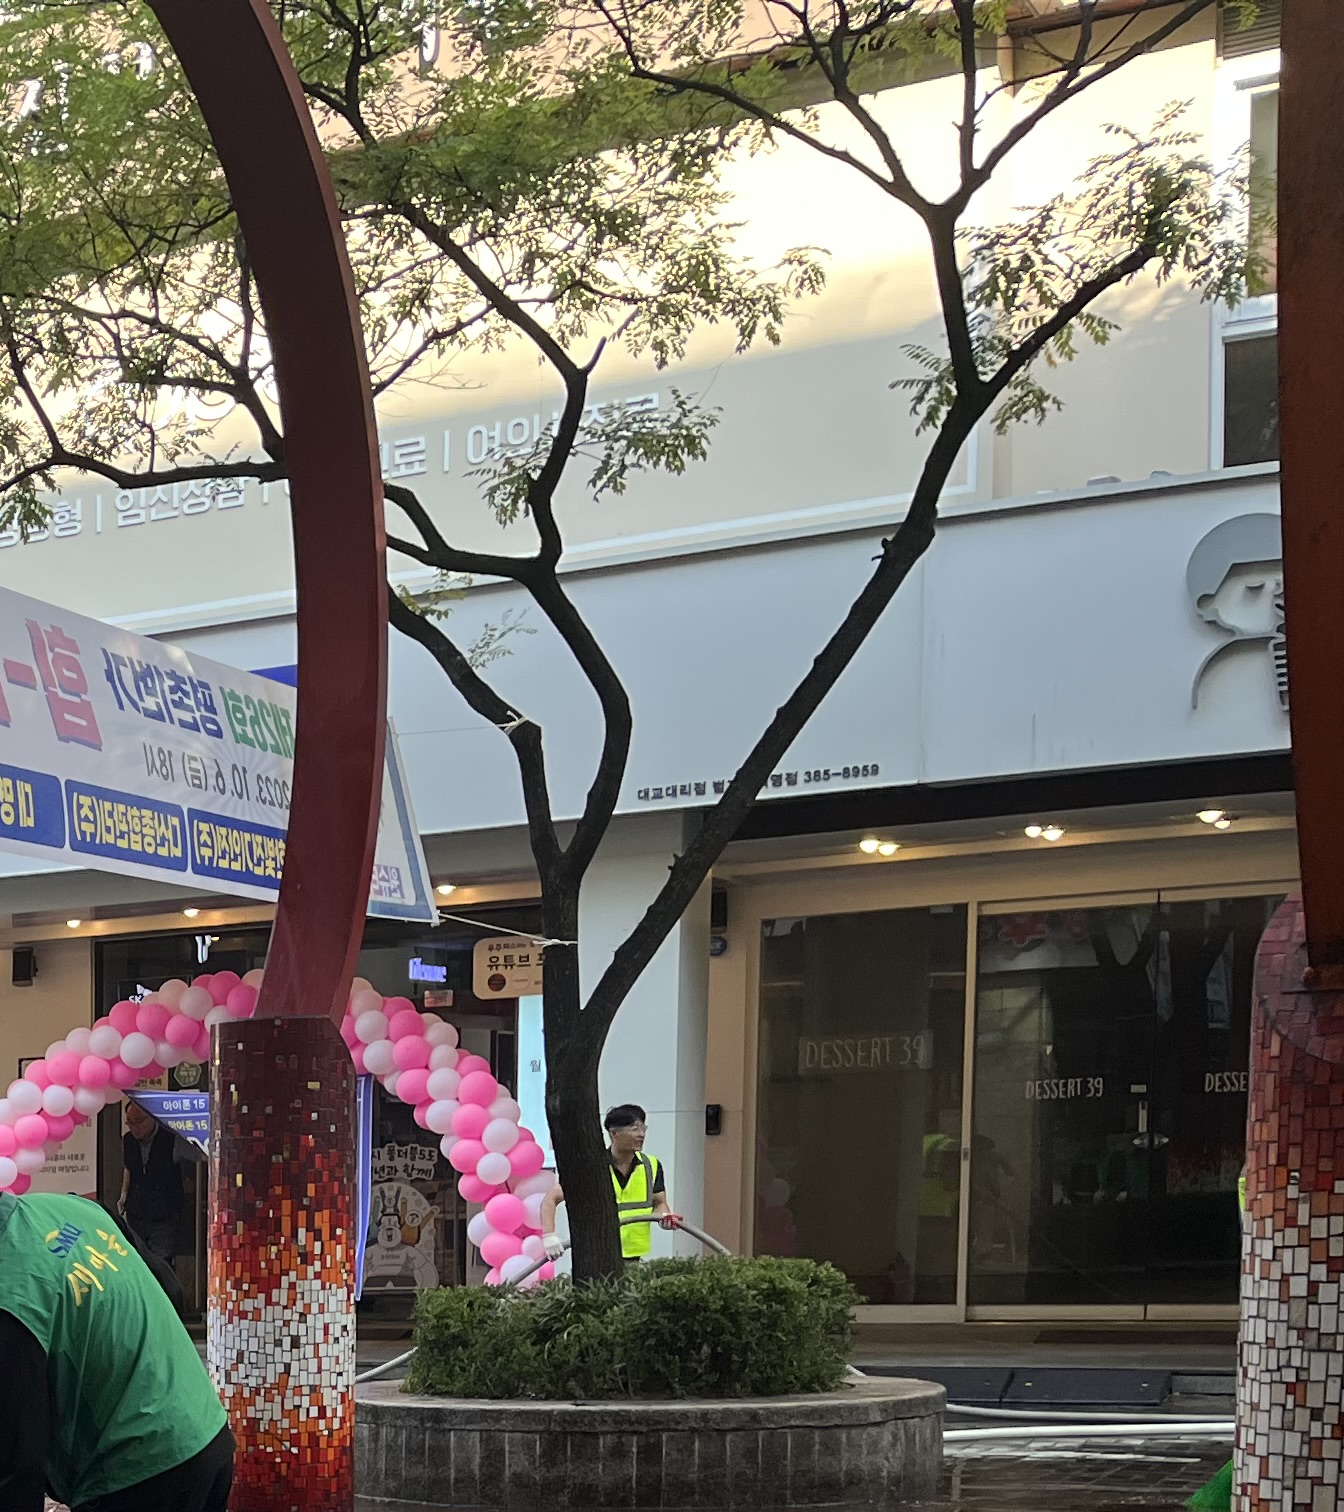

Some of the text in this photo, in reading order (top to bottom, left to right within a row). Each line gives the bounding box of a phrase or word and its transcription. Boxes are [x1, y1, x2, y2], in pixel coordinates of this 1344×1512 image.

[114, 473, 251, 528] 임신상담
[637, 780, 706, 802] 대교대리점
[803, 763, 880, 784] 385-8959
[486, 953, 532, 972] 유튜브
[804, 1035, 925, 1070] DESSERT 39
[193, 1099, 206, 1109] 15
[1025, 1077, 1104, 1099] DESSERT 39
[49, 1221, 84, 1259] SMU
